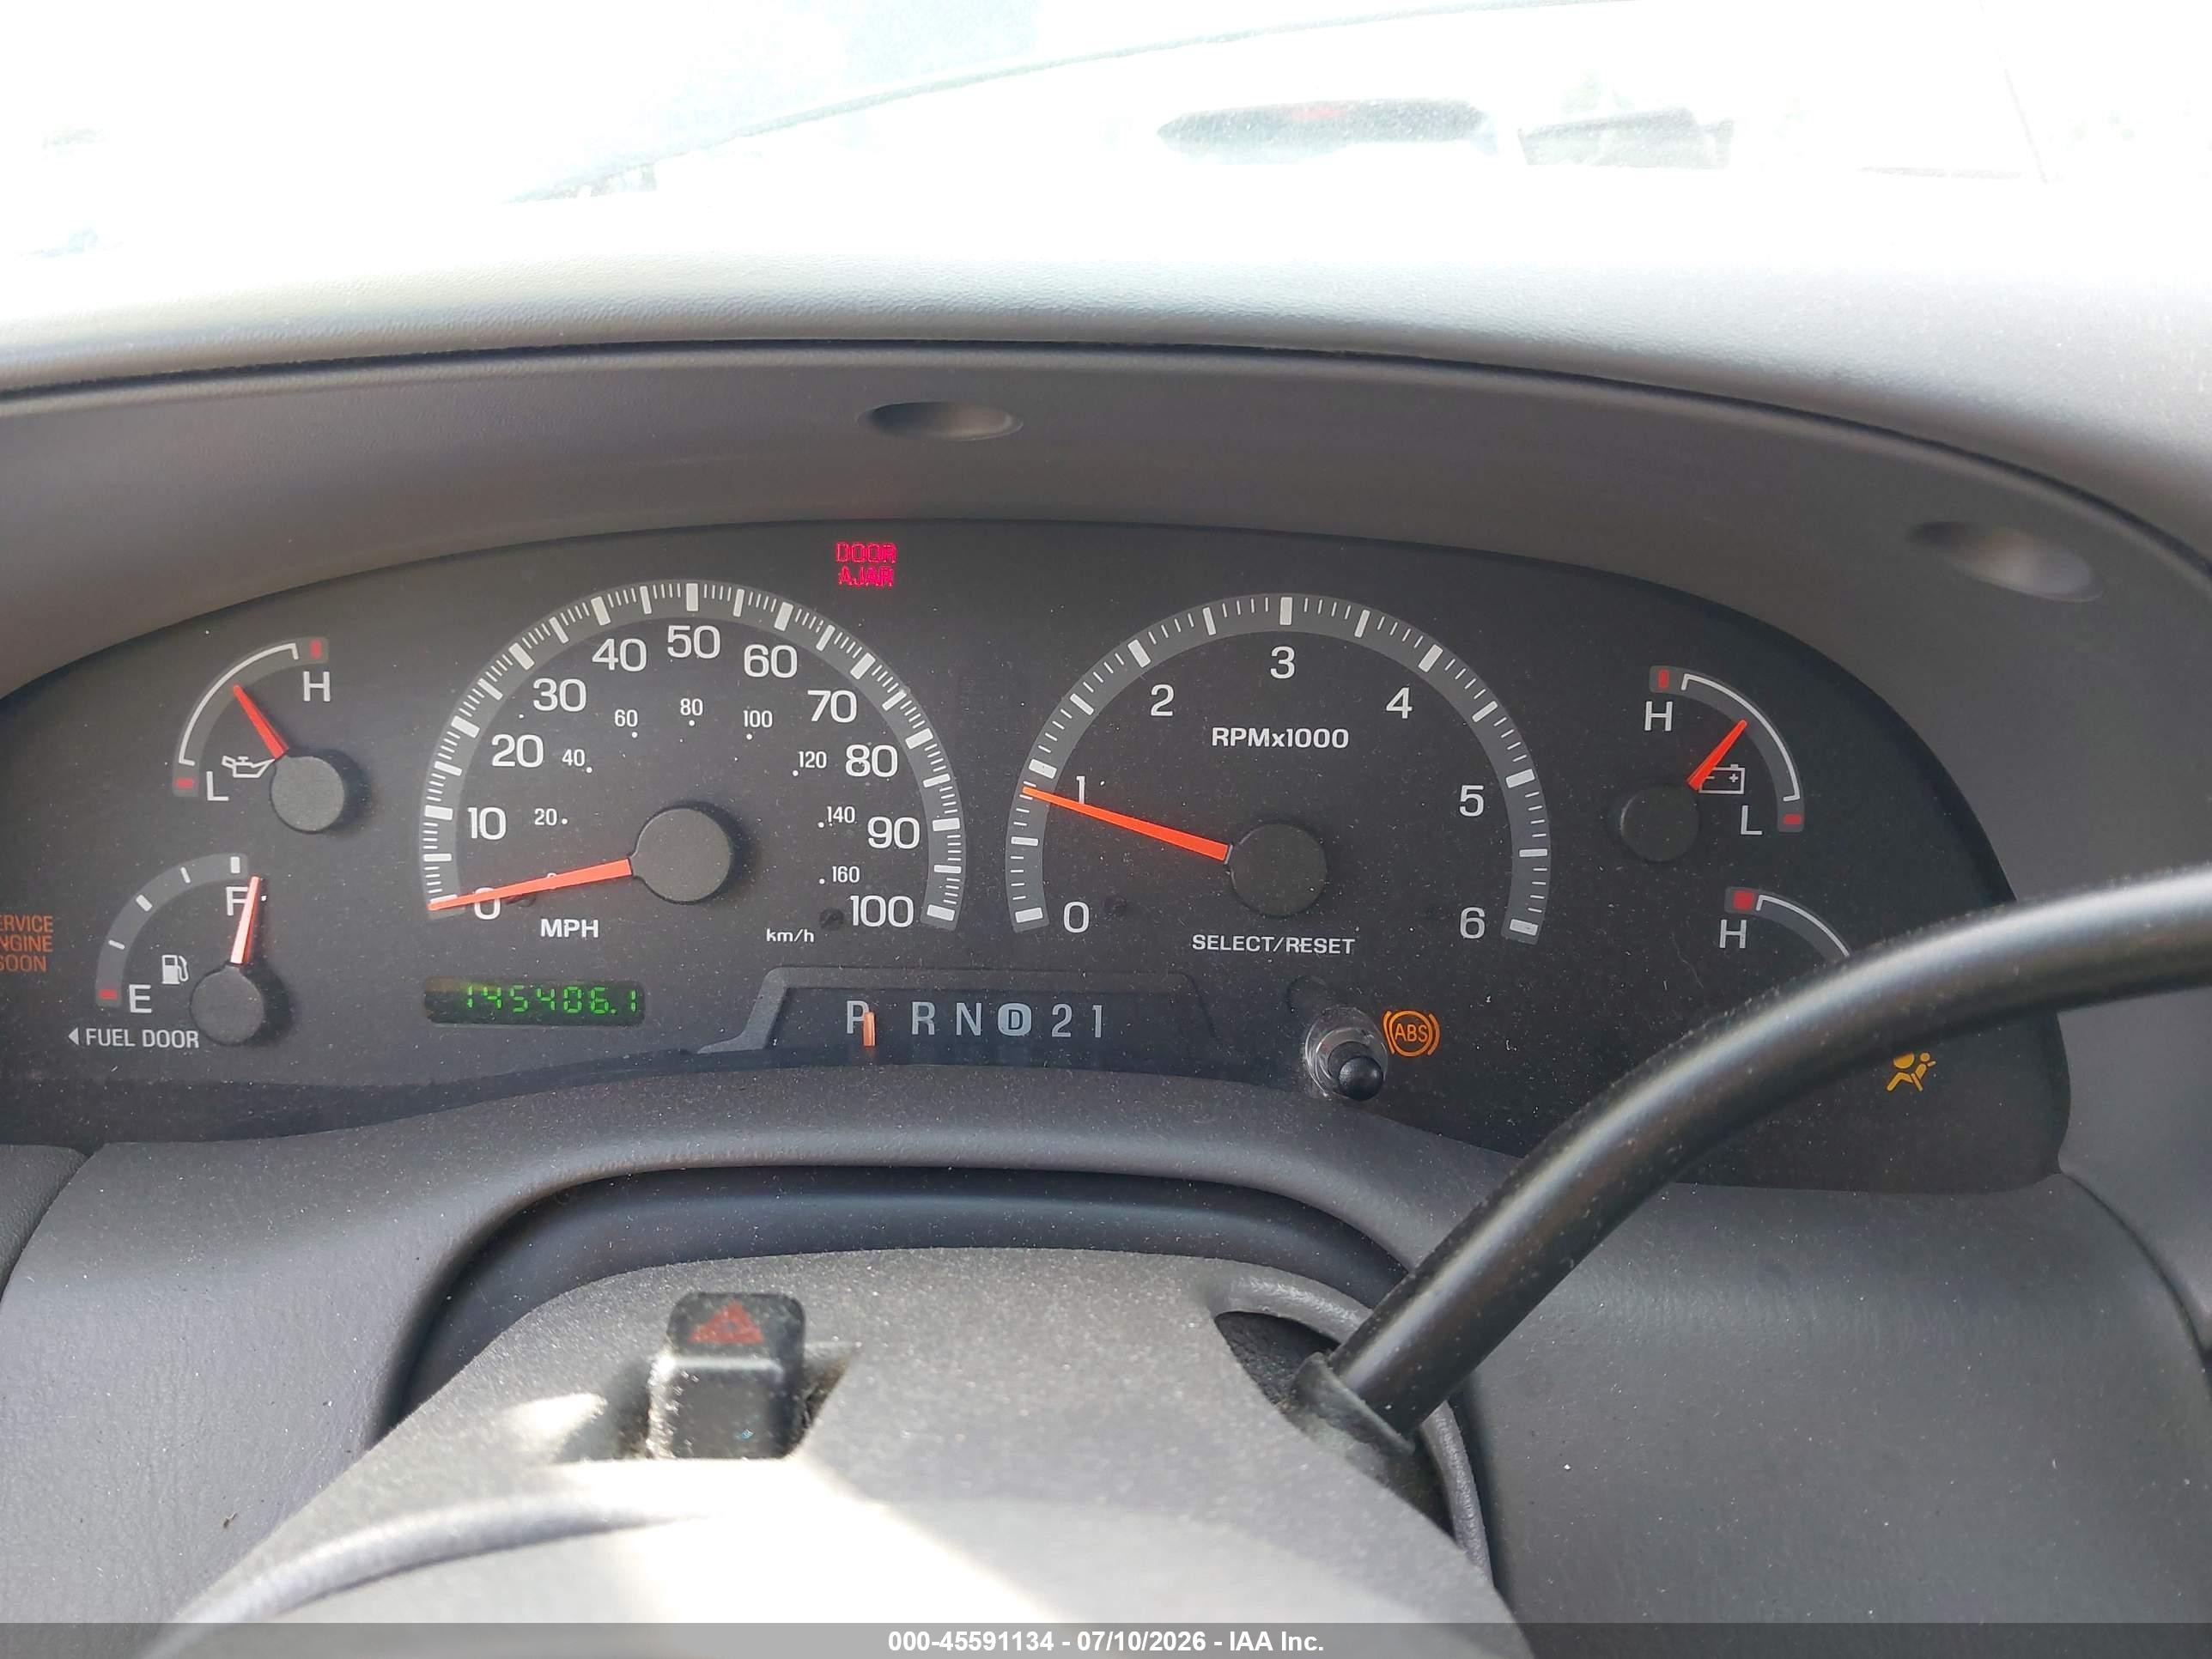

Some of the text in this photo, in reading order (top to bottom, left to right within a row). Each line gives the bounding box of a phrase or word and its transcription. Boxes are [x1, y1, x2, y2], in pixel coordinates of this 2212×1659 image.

[836, 541, 896, 563] DOOR
[838, 565, 894, 587] AJAR
[592, 638, 647, 672] 40
[667, 625, 720, 659] 50
[744, 644, 798, 678] 60
[1270, 646, 1295, 679] 3
[303, 671, 331, 702] H
[533, 678, 586, 712] 30
[1151, 684, 1175, 716] 2
[614, 708, 638, 727] 60
[680, 697, 703, 716] 80
[743, 709, 773, 728] 100
[807, 690, 857, 723] 70
[1386, 687, 1413, 719] 4
[1644, 701, 1673, 732] H
[491, 733, 544, 768] 20
[1212, 726, 1349, 749] RPMx1000
[562, 749, 586, 767] 40
[799, 750, 827, 769] 120
[845, 744, 898, 778] 80
[206, 770, 229, 801] L
[1459, 785, 1484, 817] 5
[467, 806, 507, 840] 10
[534, 808, 557, 826] 20
[827, 805, 855, 823] 140
[1741, 805, 1763, 836] L
[867, 816, 921, 849] 90
[832, 866, 860, 883] 160
[226, 886, 249, 916] F
[474, 887, 501, 921] 0
[849, 895, 915, 927] 100
[540, 918, 599, 939] MPH
[1063, 901, 1090, 933] 0
[1460, 907, 1486, 939] 6
[766, 928, 814, 943] km/h
[1192, 934, 1356, 954] SELECT/RESET
[1719, 919, 1747, 949] H
[128, 984, 152, 1013] E
[466, 985, 636, 1014] 145406.1
[847, 1000, 869, 1034] P
[911, 1001, 935, 1036] R
[956, 1002, 982, 1036] N
[1051, 1003, 1073, 1037] 2
[1091, 1005, 1103, 1038] 1
[1395, 1023, 1429, 1042] ABS
[86, 1028, 199, 1048] FUEL DOOR
